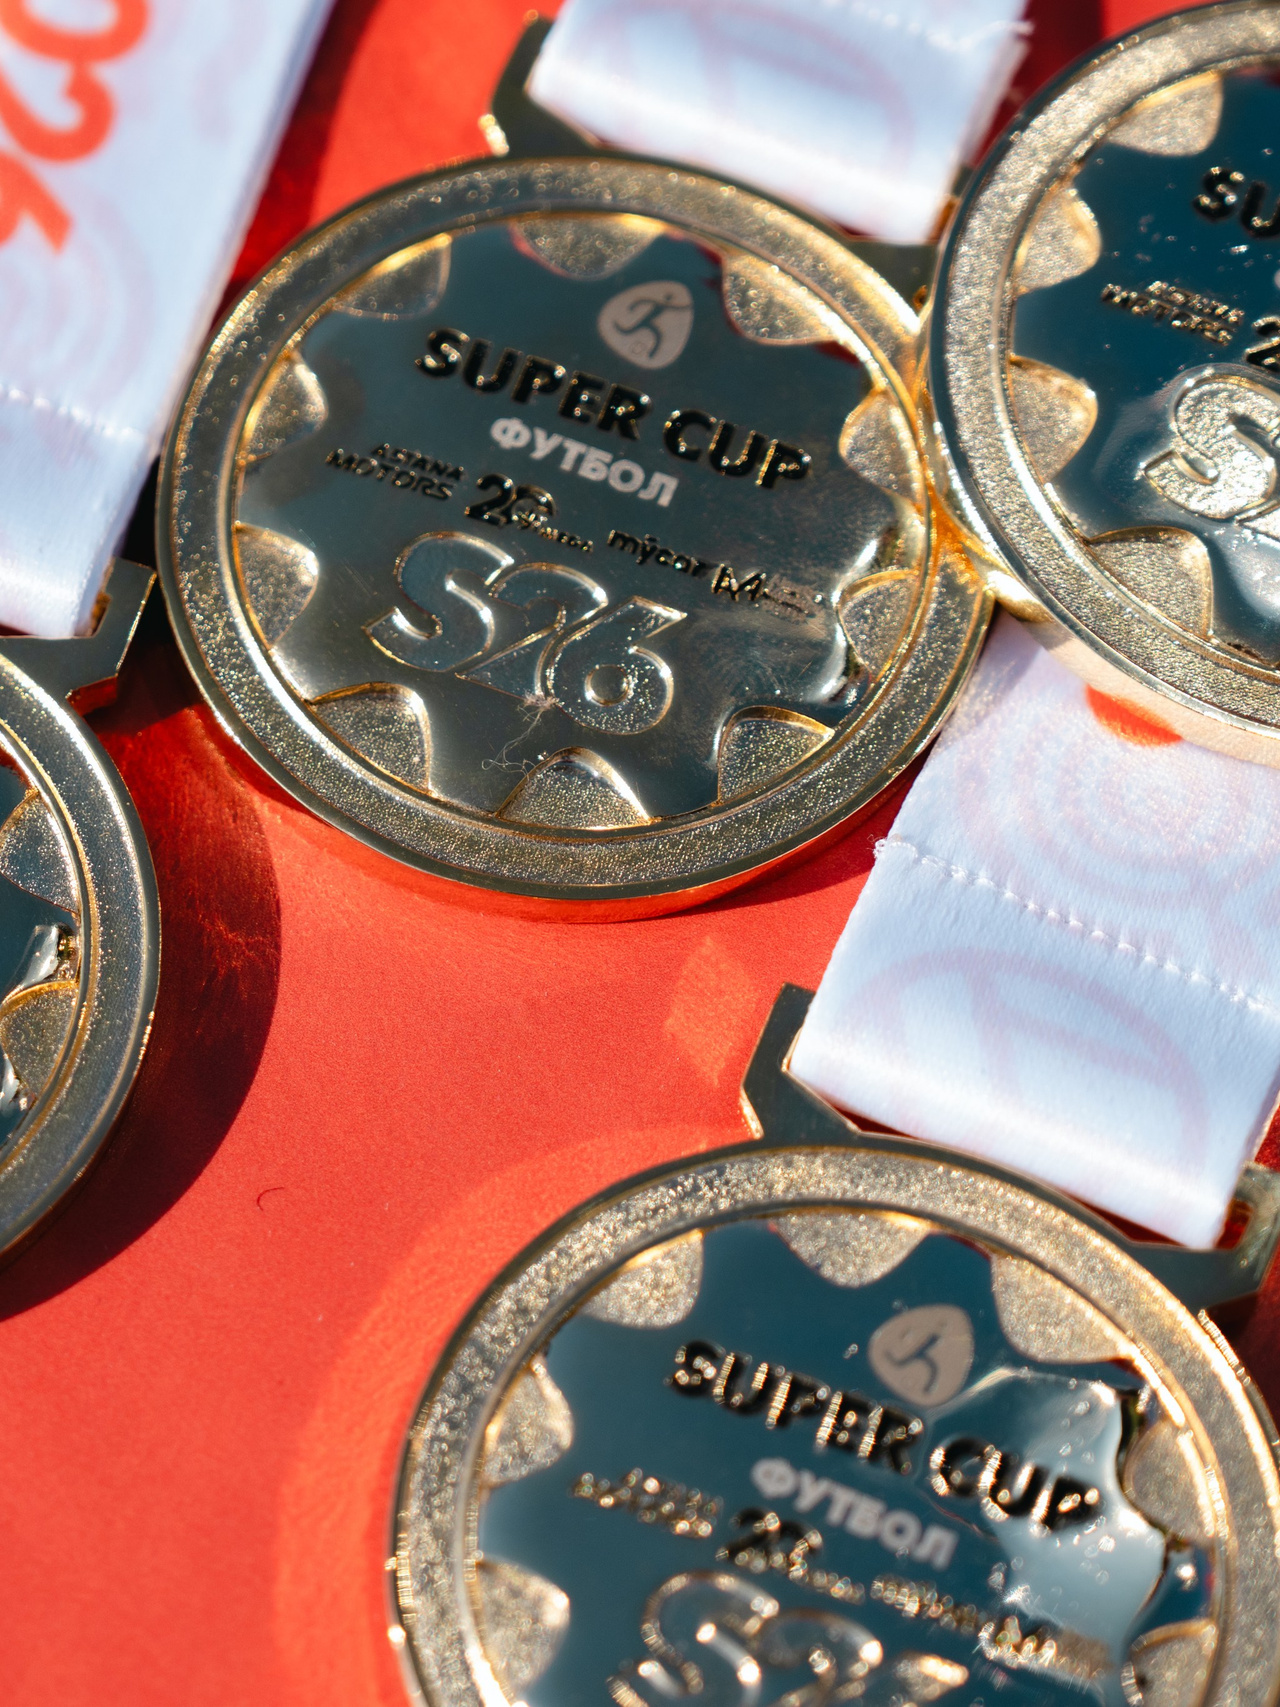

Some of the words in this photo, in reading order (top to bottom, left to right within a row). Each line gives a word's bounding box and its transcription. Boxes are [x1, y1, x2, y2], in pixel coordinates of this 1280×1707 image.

[325, 449, 457, 500] MOTORS
[417, 328, 653, 440] SUPER
[663, 408, 813, 489] CUP
[491, 416, 679, 508] ФУТБОЛ
[1142, 370, 1280, 540] S
[361, 530, 688, 735] S26
[664, 1340, 924, 1474] SUPER
[928, 1438, 1101, 1536] CUP
[750, 1456, 959, 1569] ФУТБОЛ
